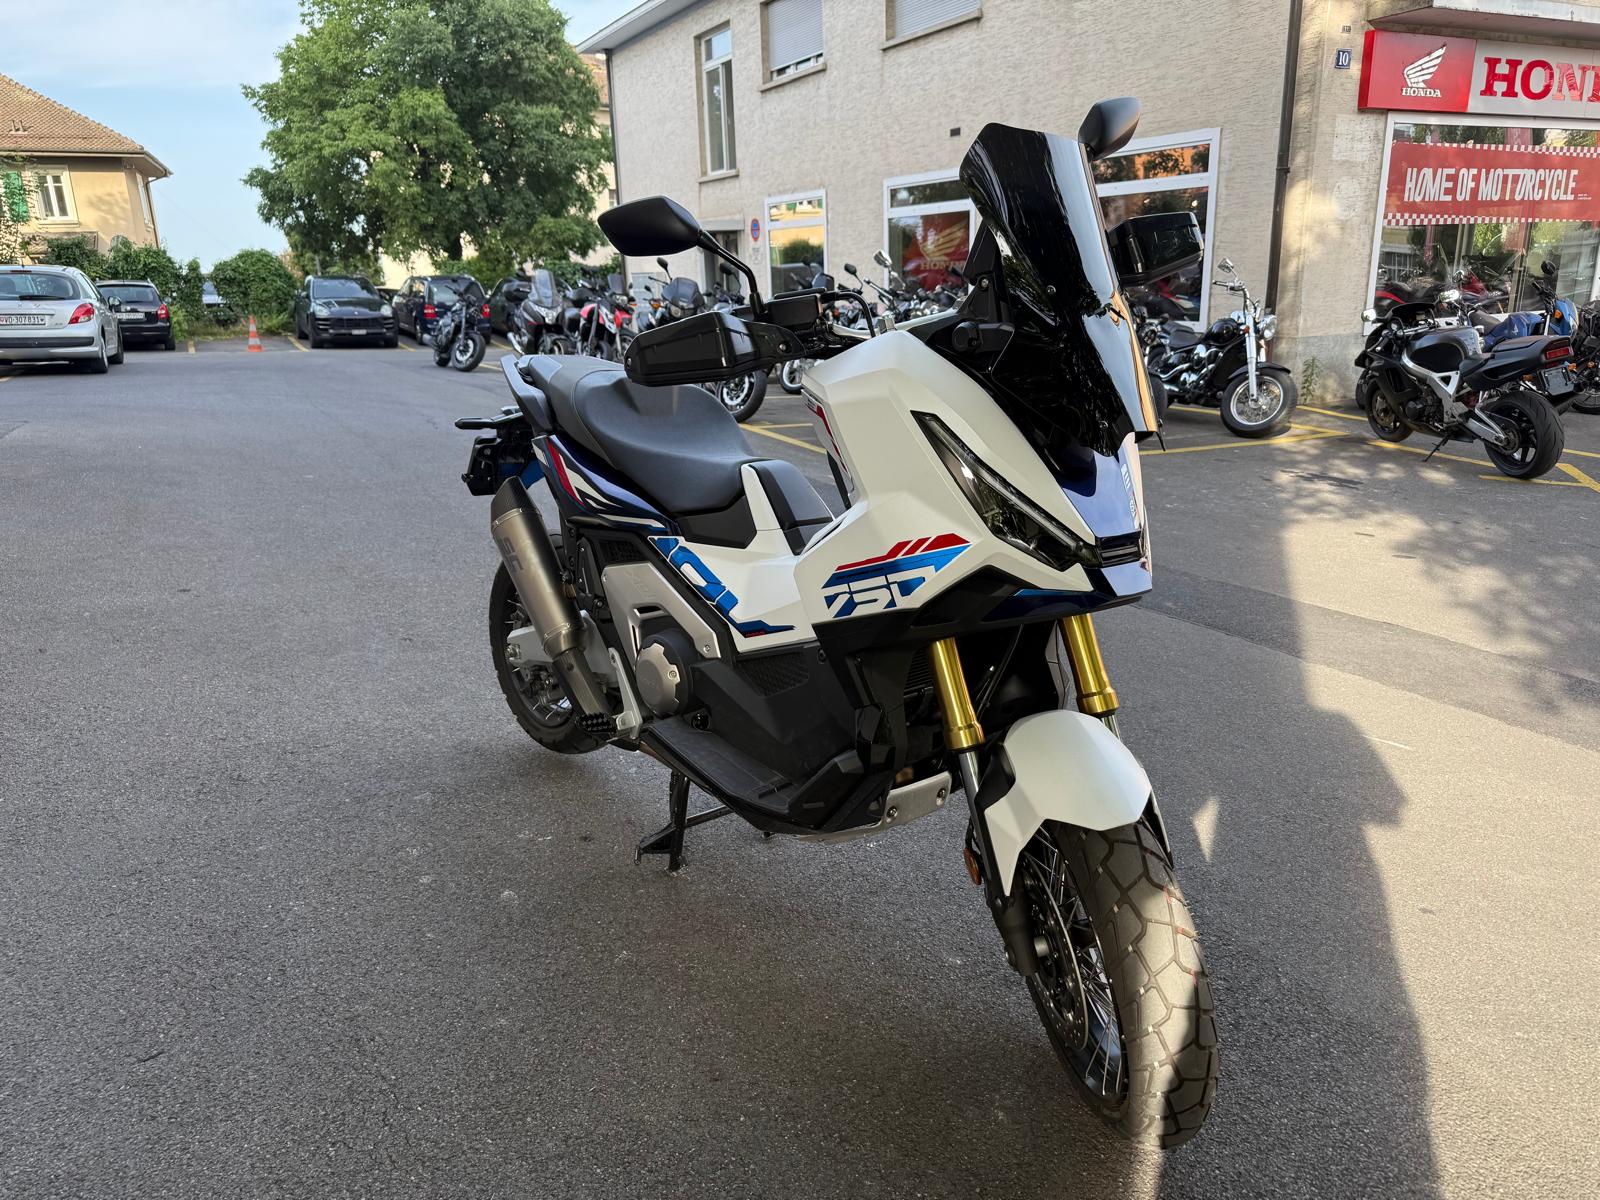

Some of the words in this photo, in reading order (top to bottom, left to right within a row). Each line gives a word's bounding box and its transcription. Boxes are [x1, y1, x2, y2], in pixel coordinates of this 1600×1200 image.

[1338, 51, 1349, 66] 10
[1401, 86, 1442, 98] HONDA
[1403, 167, 1456, 202] HOME
[1456, 167, 1478, 201] OF
[1477, 168, 1579, 201] MOTORCYCLE
